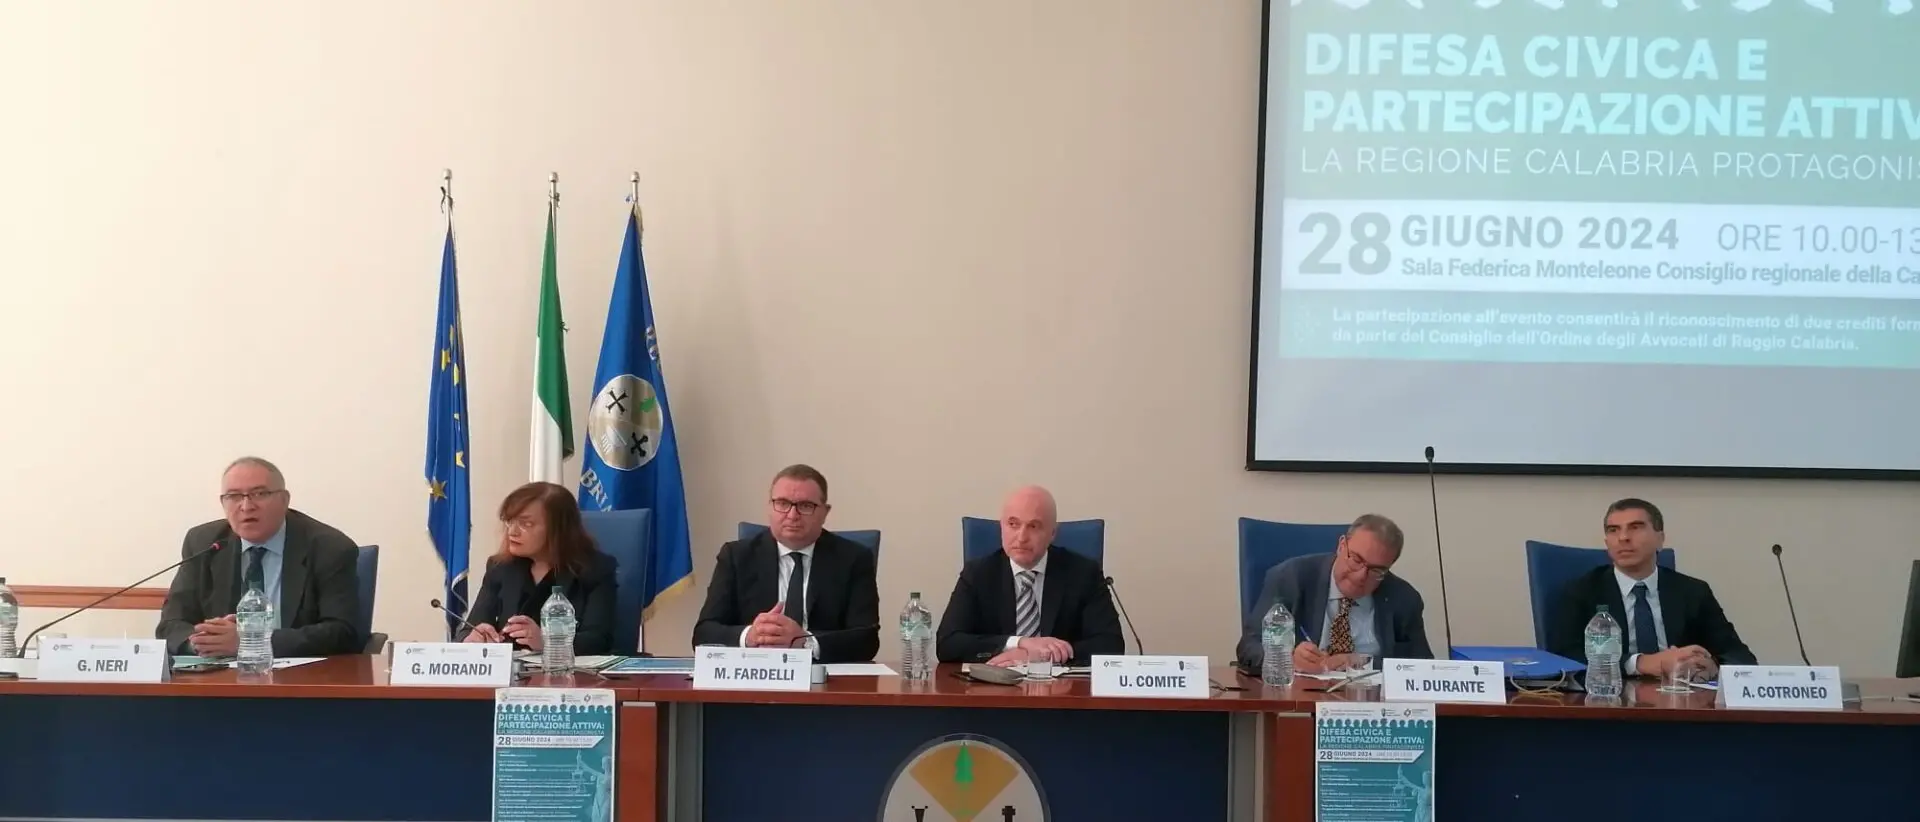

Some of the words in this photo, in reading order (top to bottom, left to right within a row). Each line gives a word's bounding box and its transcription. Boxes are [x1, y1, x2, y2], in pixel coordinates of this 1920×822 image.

[1305, 33, 1506, 76] DIFESA
[1523, 35, 1719, 80] CIVICA
[1737, 39, 1768, 81] E
[1303, 89, 1766, 137] PARTECIPAZIONE
[1301, 147, 1342, 173] LA
[1357, 147, 1511, 173] REGIONE
[1525, 148, 1699, 177] CALABRIA
[1713, 152, 1920, 180] PROTAGONI
[1298, 211, 1392, 275] 28
[1401, 214, 1563, 249] GIUGNO
[1578, 216, 1679, 250] 2024
[1717, 222, 1782, 251] ORE
[1401, 257, 1444, 276] Sala
[1448, 257, 1530, 278] Federica
[1536, 259, 1651, 279] Monteleone
[1656, 260, 1747, 285] Consiglio
[1751, 263, 1841, 286] regionale
[1846, 264, 1892, 284] della
[1332, 308, 1350, 322] La
[1355, 308, 1472, 325] partecipazione
[1475, 309, 1551, 325] all'evento
[1658, 314, 1780, 329] riconoscimento
[1784, 314, 1799, 329] di
[1803, 315, 1832, 329] due
[1836, 316, 1886, 330] crediti
[1332, 329, 1350, 343] da
[1355, 330, 1397, 345] parte
[1401, 329, 1425, 343] del
[1428, 330, 1502, 347] Consiglio
[1506, 330, 1592, 346] dell'Ordine
[1596, 332, 1636, 349] degli
[1640, 332, 1708, 348] Avvocati
[1712, 333, 1727, 348] di
[77, 659, 91, 672] G.
[95, 659, 129, 673] NERI
[411, 662, 425, 675] G.
[428, 663, 492, 676] MORANDI
[714, 667, 730, 680] M.
[734, 668, 795, 681] FARDELLI
[1119, 675, 1133, 688] U.
[1136, 675, 1187, 688] COMITE
[1405, 679, 1419, 691] N.
[1423, 680, 1485, 693] DURANTE
[1742, 686, 1755, 698] A.
[1757, 686, 1828, 699] COTRONEO
[498, 721, 571, 729] PARTECIPAZIONE
[1320, 728, 1352, 736] DIFESA
[1353, 728, 1384, 736] CIVICA
[498, 736, 511, 746] 28
[1320, 736, 1391, 744] PARTECIPAZIONE
[1320, 750, 1333, 760] 28
